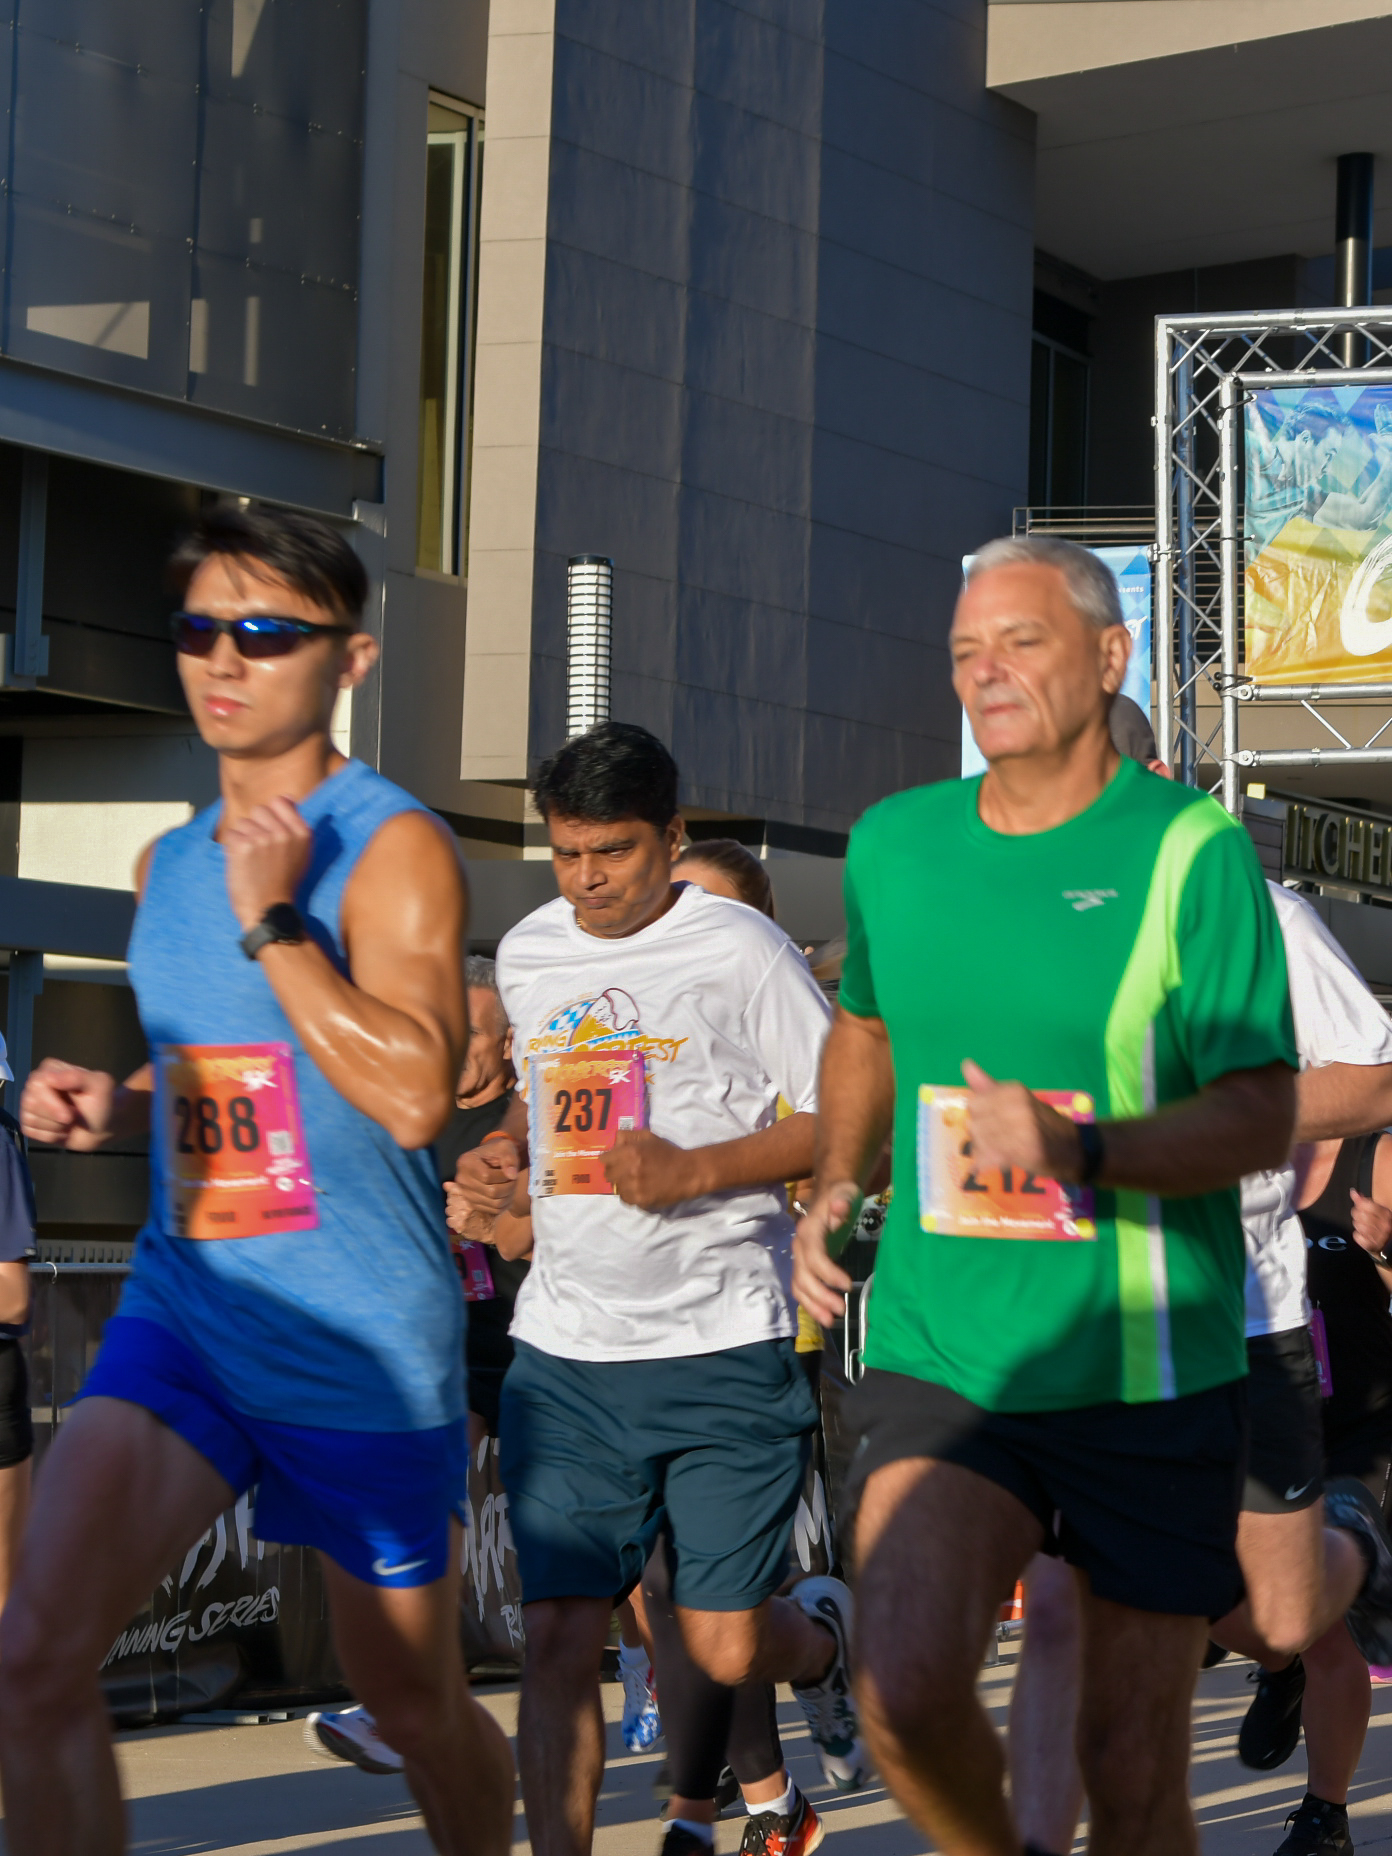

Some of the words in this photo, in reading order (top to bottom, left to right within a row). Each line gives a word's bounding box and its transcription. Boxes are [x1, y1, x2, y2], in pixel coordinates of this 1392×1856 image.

[174, 1095, 260, 1154] 288
[554, 1088, 613, 1133] 237
[188, 1585, 281, 1642] SERIES
